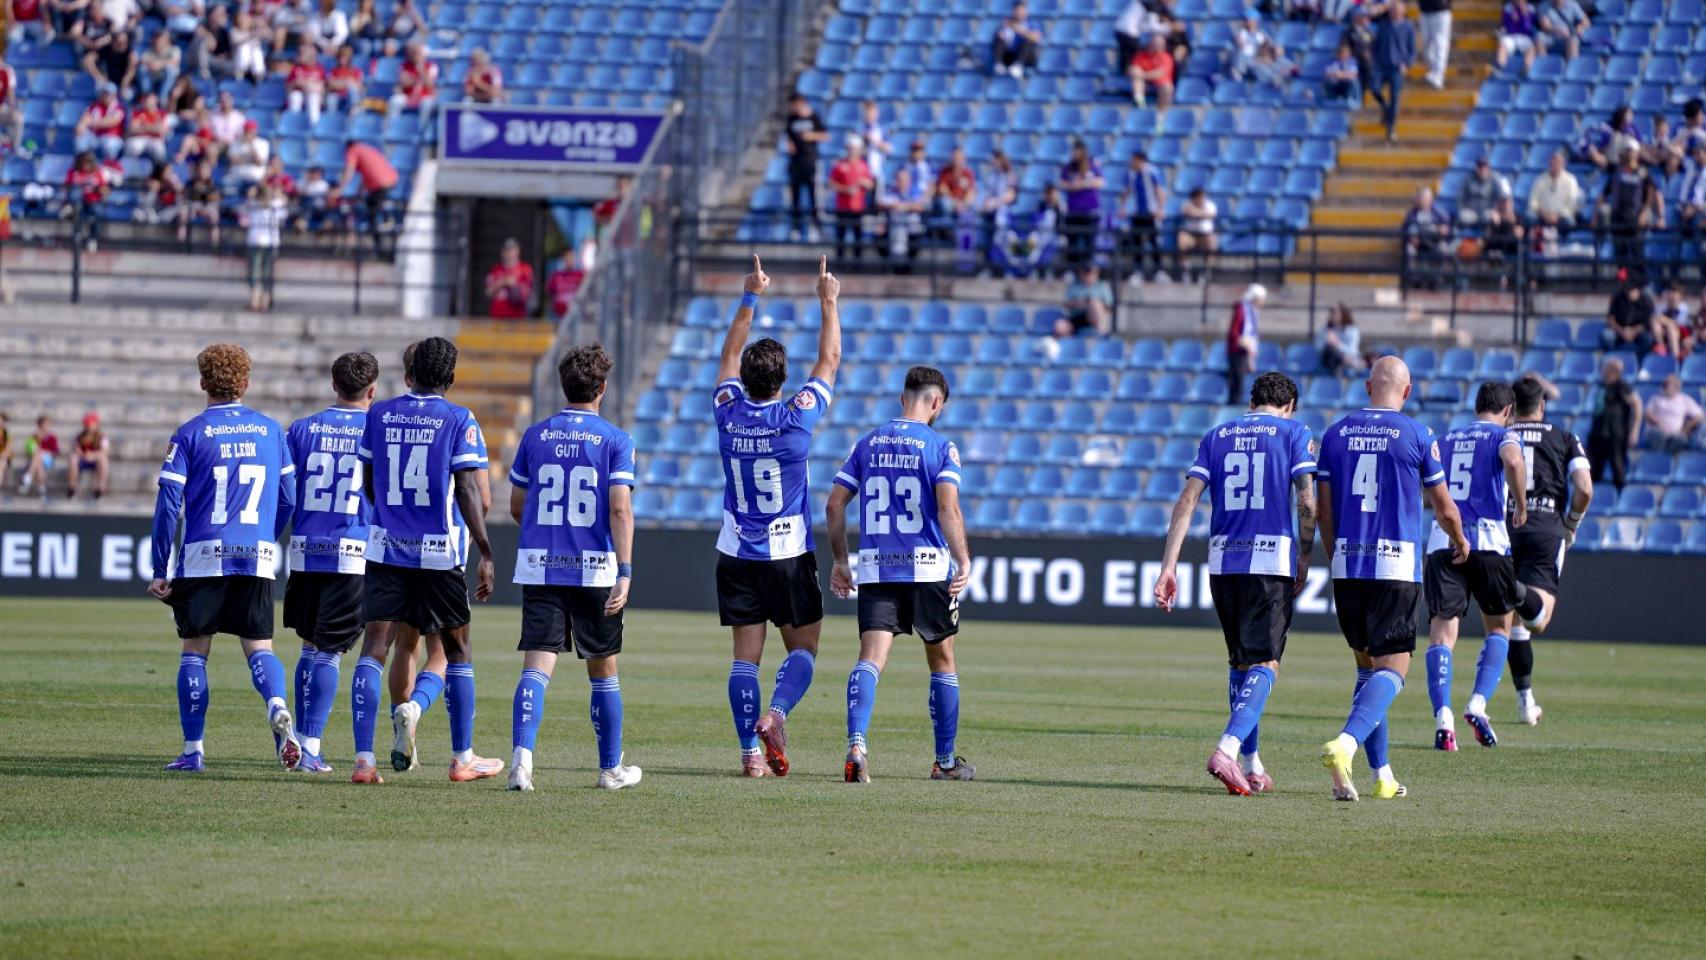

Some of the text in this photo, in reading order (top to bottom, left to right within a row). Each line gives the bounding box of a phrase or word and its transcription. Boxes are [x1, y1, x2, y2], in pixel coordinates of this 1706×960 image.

[505, 120, 637, 148] avanza
[220, 444, 232, 459] DE
[314, 424, 365, 437] alibuildin
[321, 437, 356, 453] ARANDA
[385, 427, 435, 443] BEN HAMED
[555, 444, 579, 458] GUTI
[732, 437, 772, 453] FRAN SOL
[1234, 437, 1257, 451] RETU
[1348, 437, 1388, 452] RENTERO
[303, 452, 364, 515] 22
[386, 444, 431, 507] 14
[879, 454, 920, 469] CALAVERA
[1224, 453, 1265, 511] 21
[1352, 453, 1379, 513] 4
[1449, 452, 1474, 501] 5
[211, 464, 266, 525] 17
[537, 464, 598, 527] 26
[730, 458, 784, 514] 19
[866, 476, 923, 535] 23
[1, 532, 79, 578] EN
[957, 556, 1086, 606] XITO
